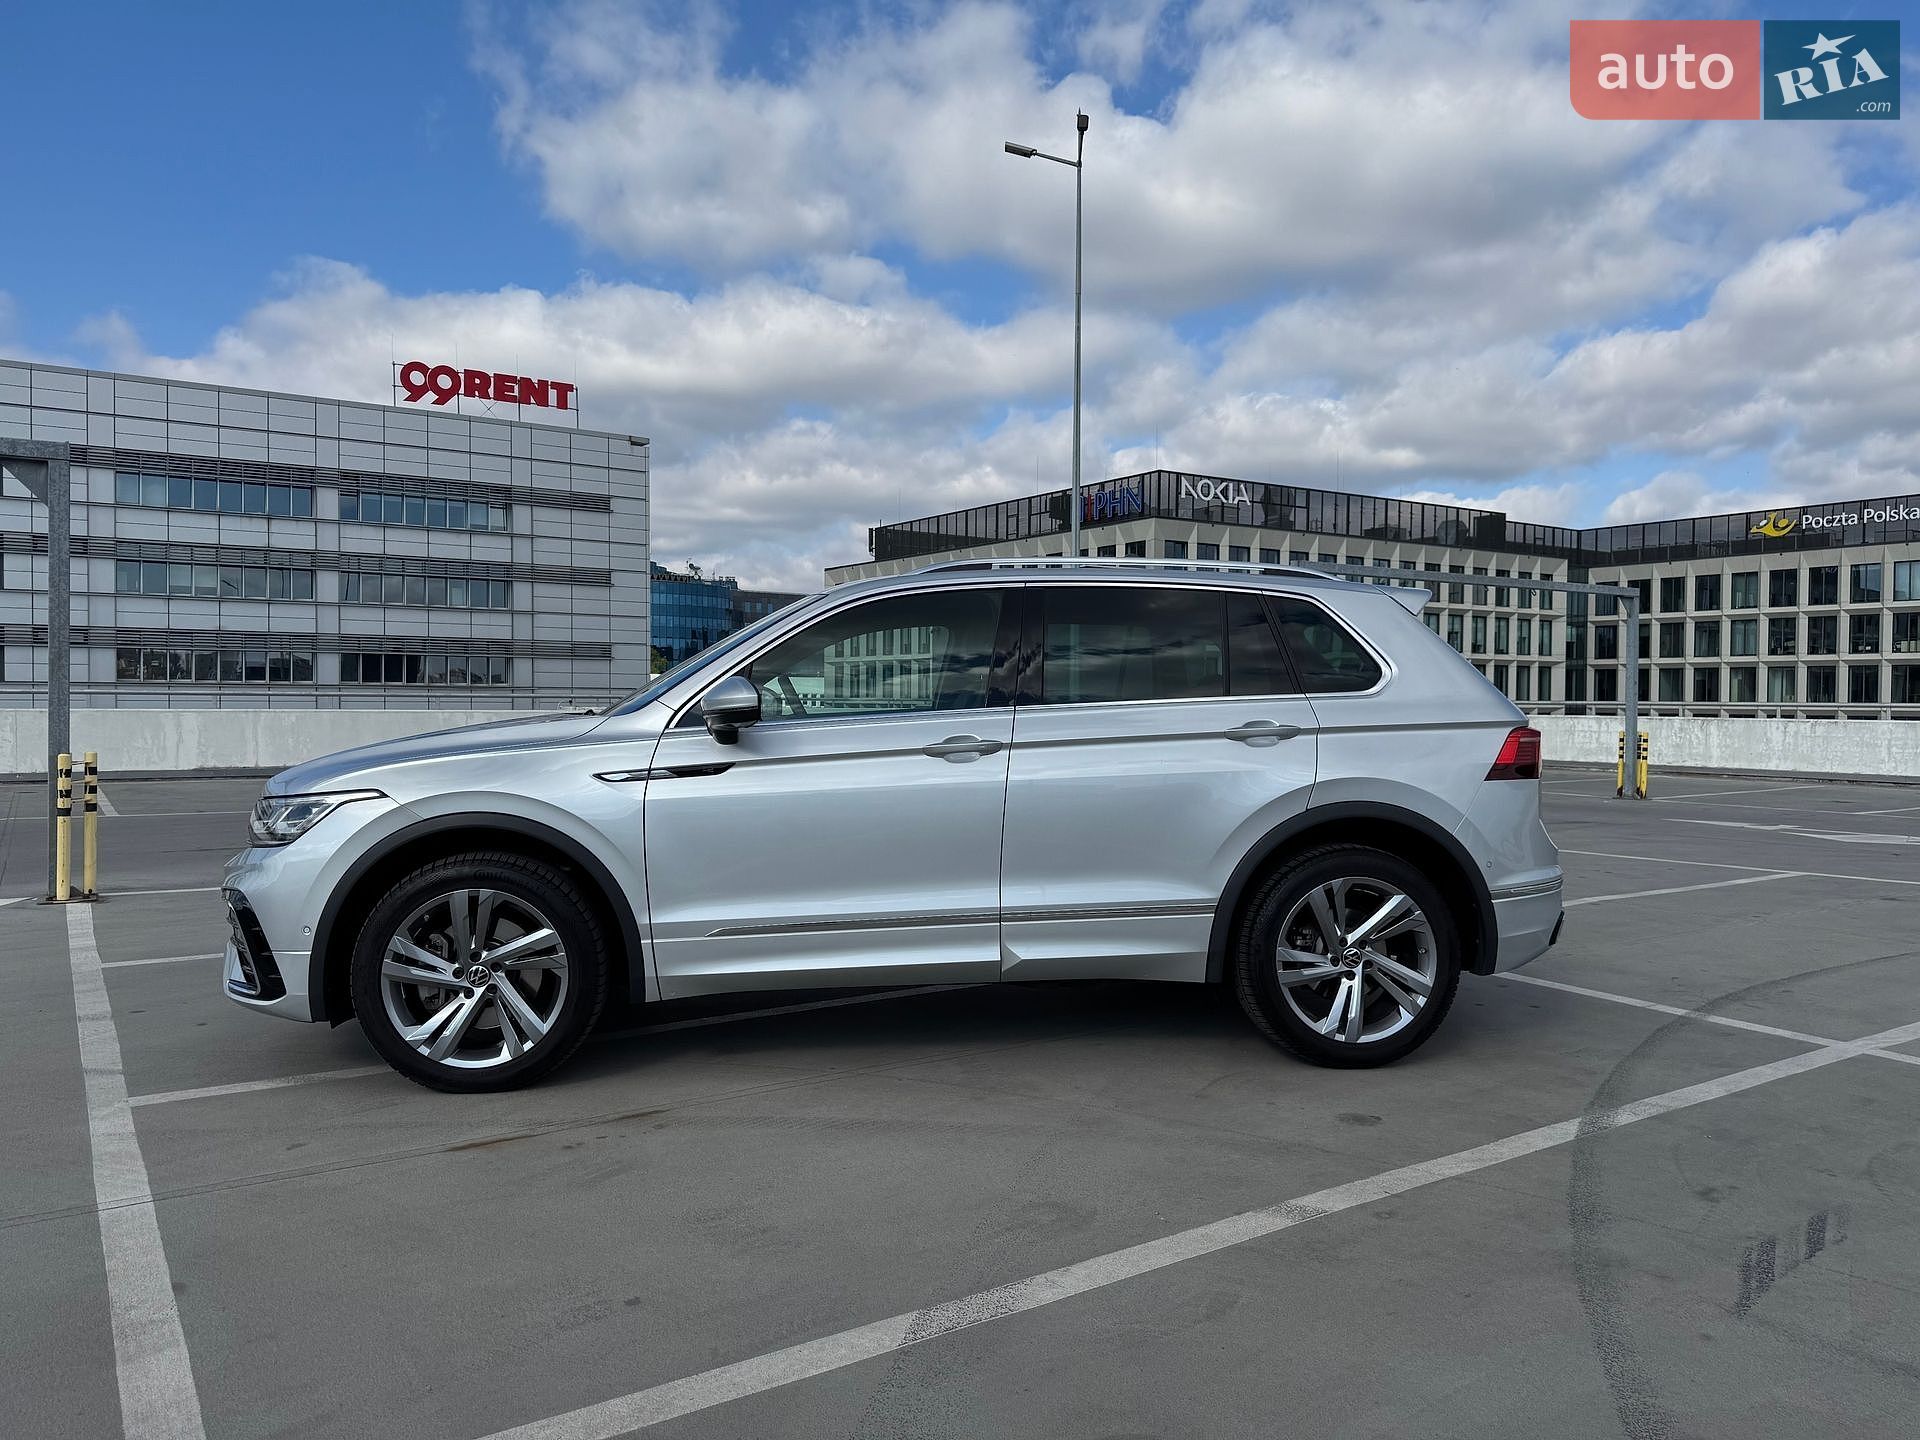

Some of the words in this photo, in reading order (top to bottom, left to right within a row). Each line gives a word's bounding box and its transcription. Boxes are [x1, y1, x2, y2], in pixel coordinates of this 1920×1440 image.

[1094, 482, 1143, 520] PHN
[1181, 476, 1251, 506] NOKIA
[1802, 512, 1858, 529] Poczta
[1863, 504, 1920, 524] Polska
